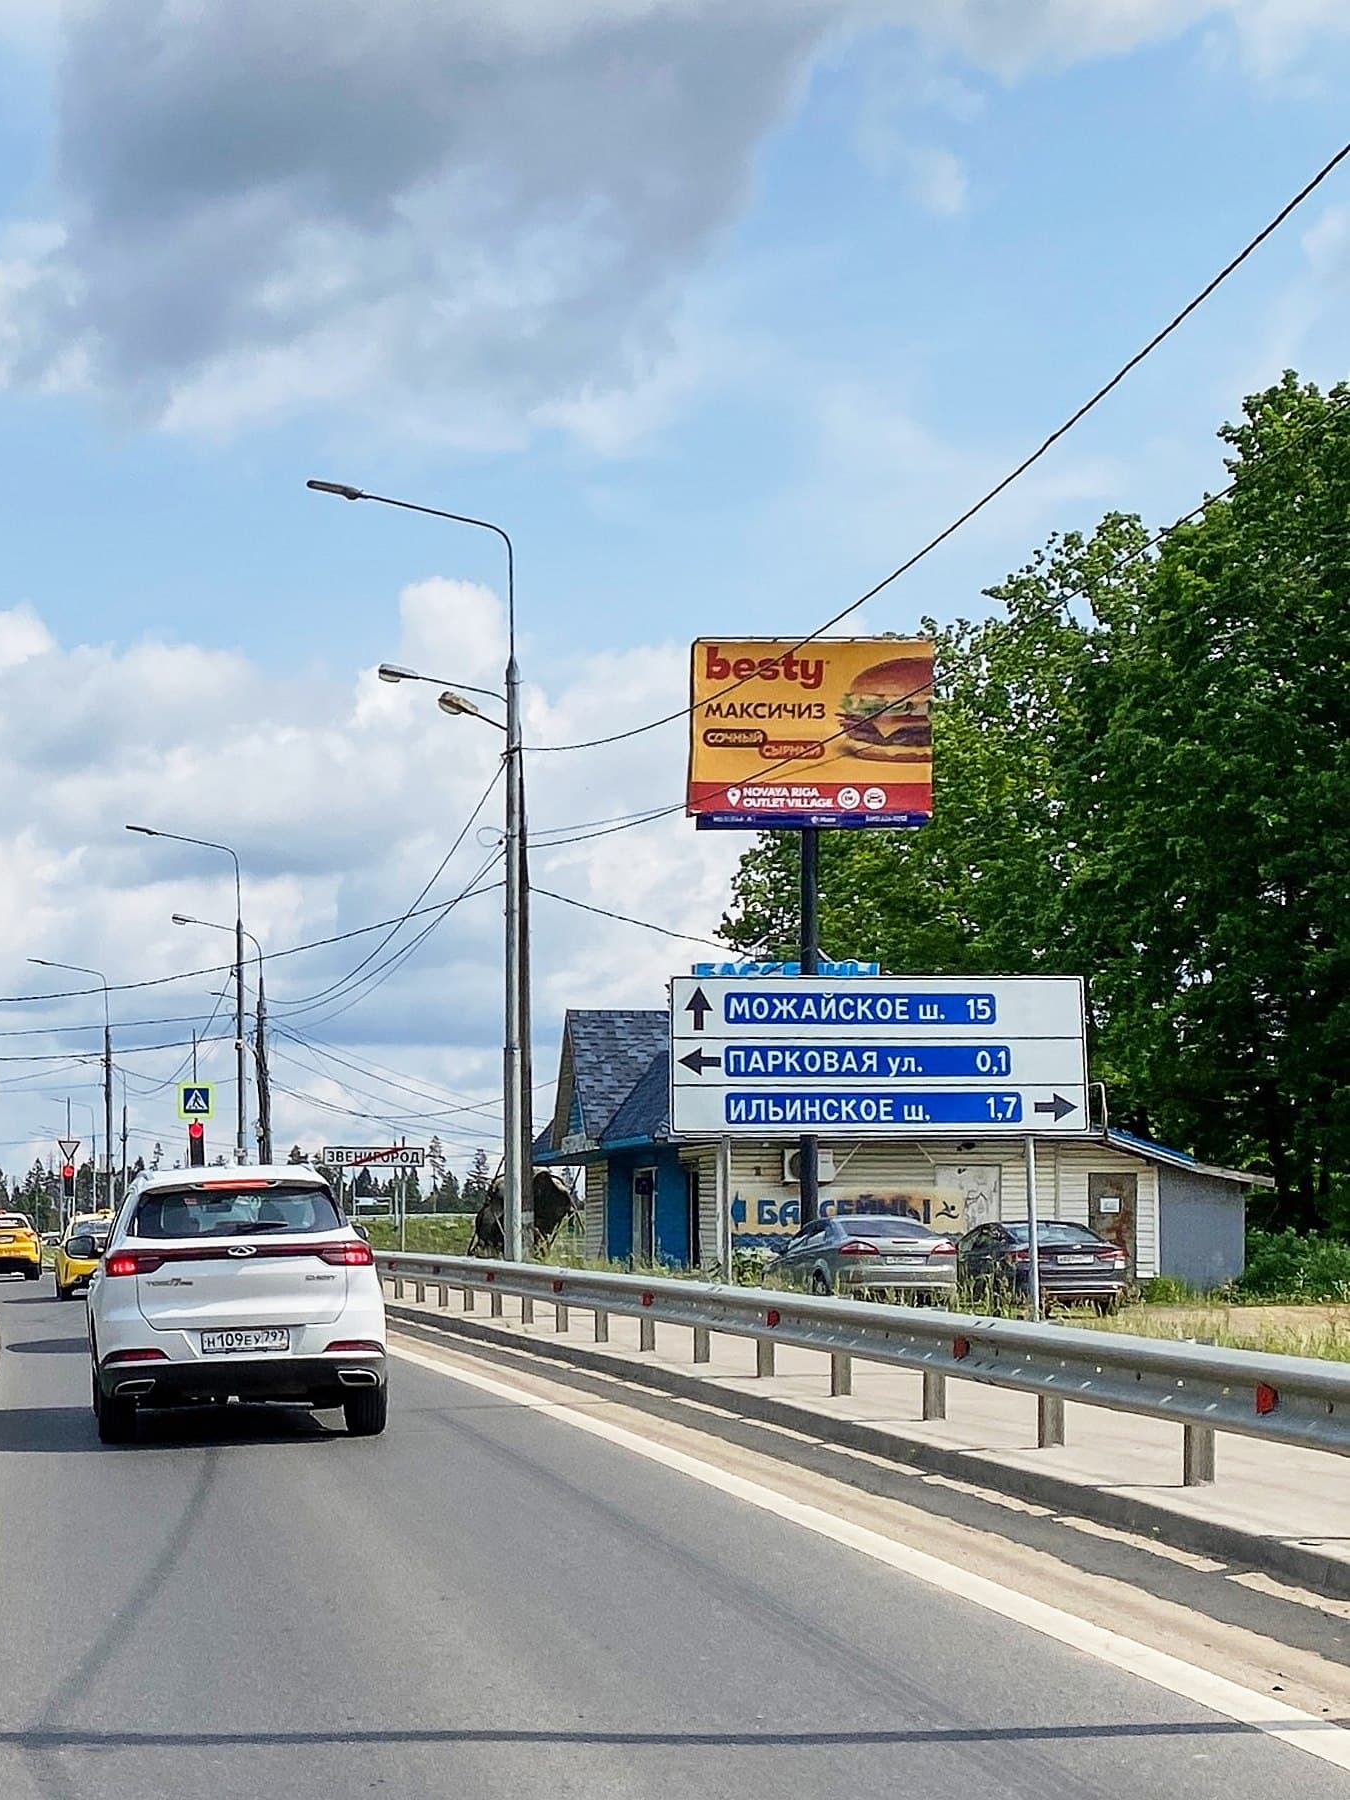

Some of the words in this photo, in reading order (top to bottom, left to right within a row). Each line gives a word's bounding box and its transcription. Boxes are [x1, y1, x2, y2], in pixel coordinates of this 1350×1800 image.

[705, 646, 824, 690] besty
[704, 702, 826, 719] МАКСИЧИЗ
[742, 787, 789, 798] NOVAYA
[791, 787, 820, 798] RIGA
[742, 798, 786, 808] OUTLET
[786, 798, 834, 808] VILLAGE
[728, 994, 910, 1020] МОЖАЙСКОЕ
[919, 1004, 946, 1020] ш.
[966, 999, 992, 1020] 15
[728, 1050, 878, 1073] ПАРКОВАЯ
[888, 1057, 924, 1078] ул.
[975, 1050, 1008, 1075] 0,1
[729, 1098, 894, 1121] ИЛЬИНСКОЕ
[903, 1104, 931, 1122] ш.
[986, 1096, 1018, 1121] 1,7
[326, 1150, 420, 1164] ЗВЕНИГОРОД
